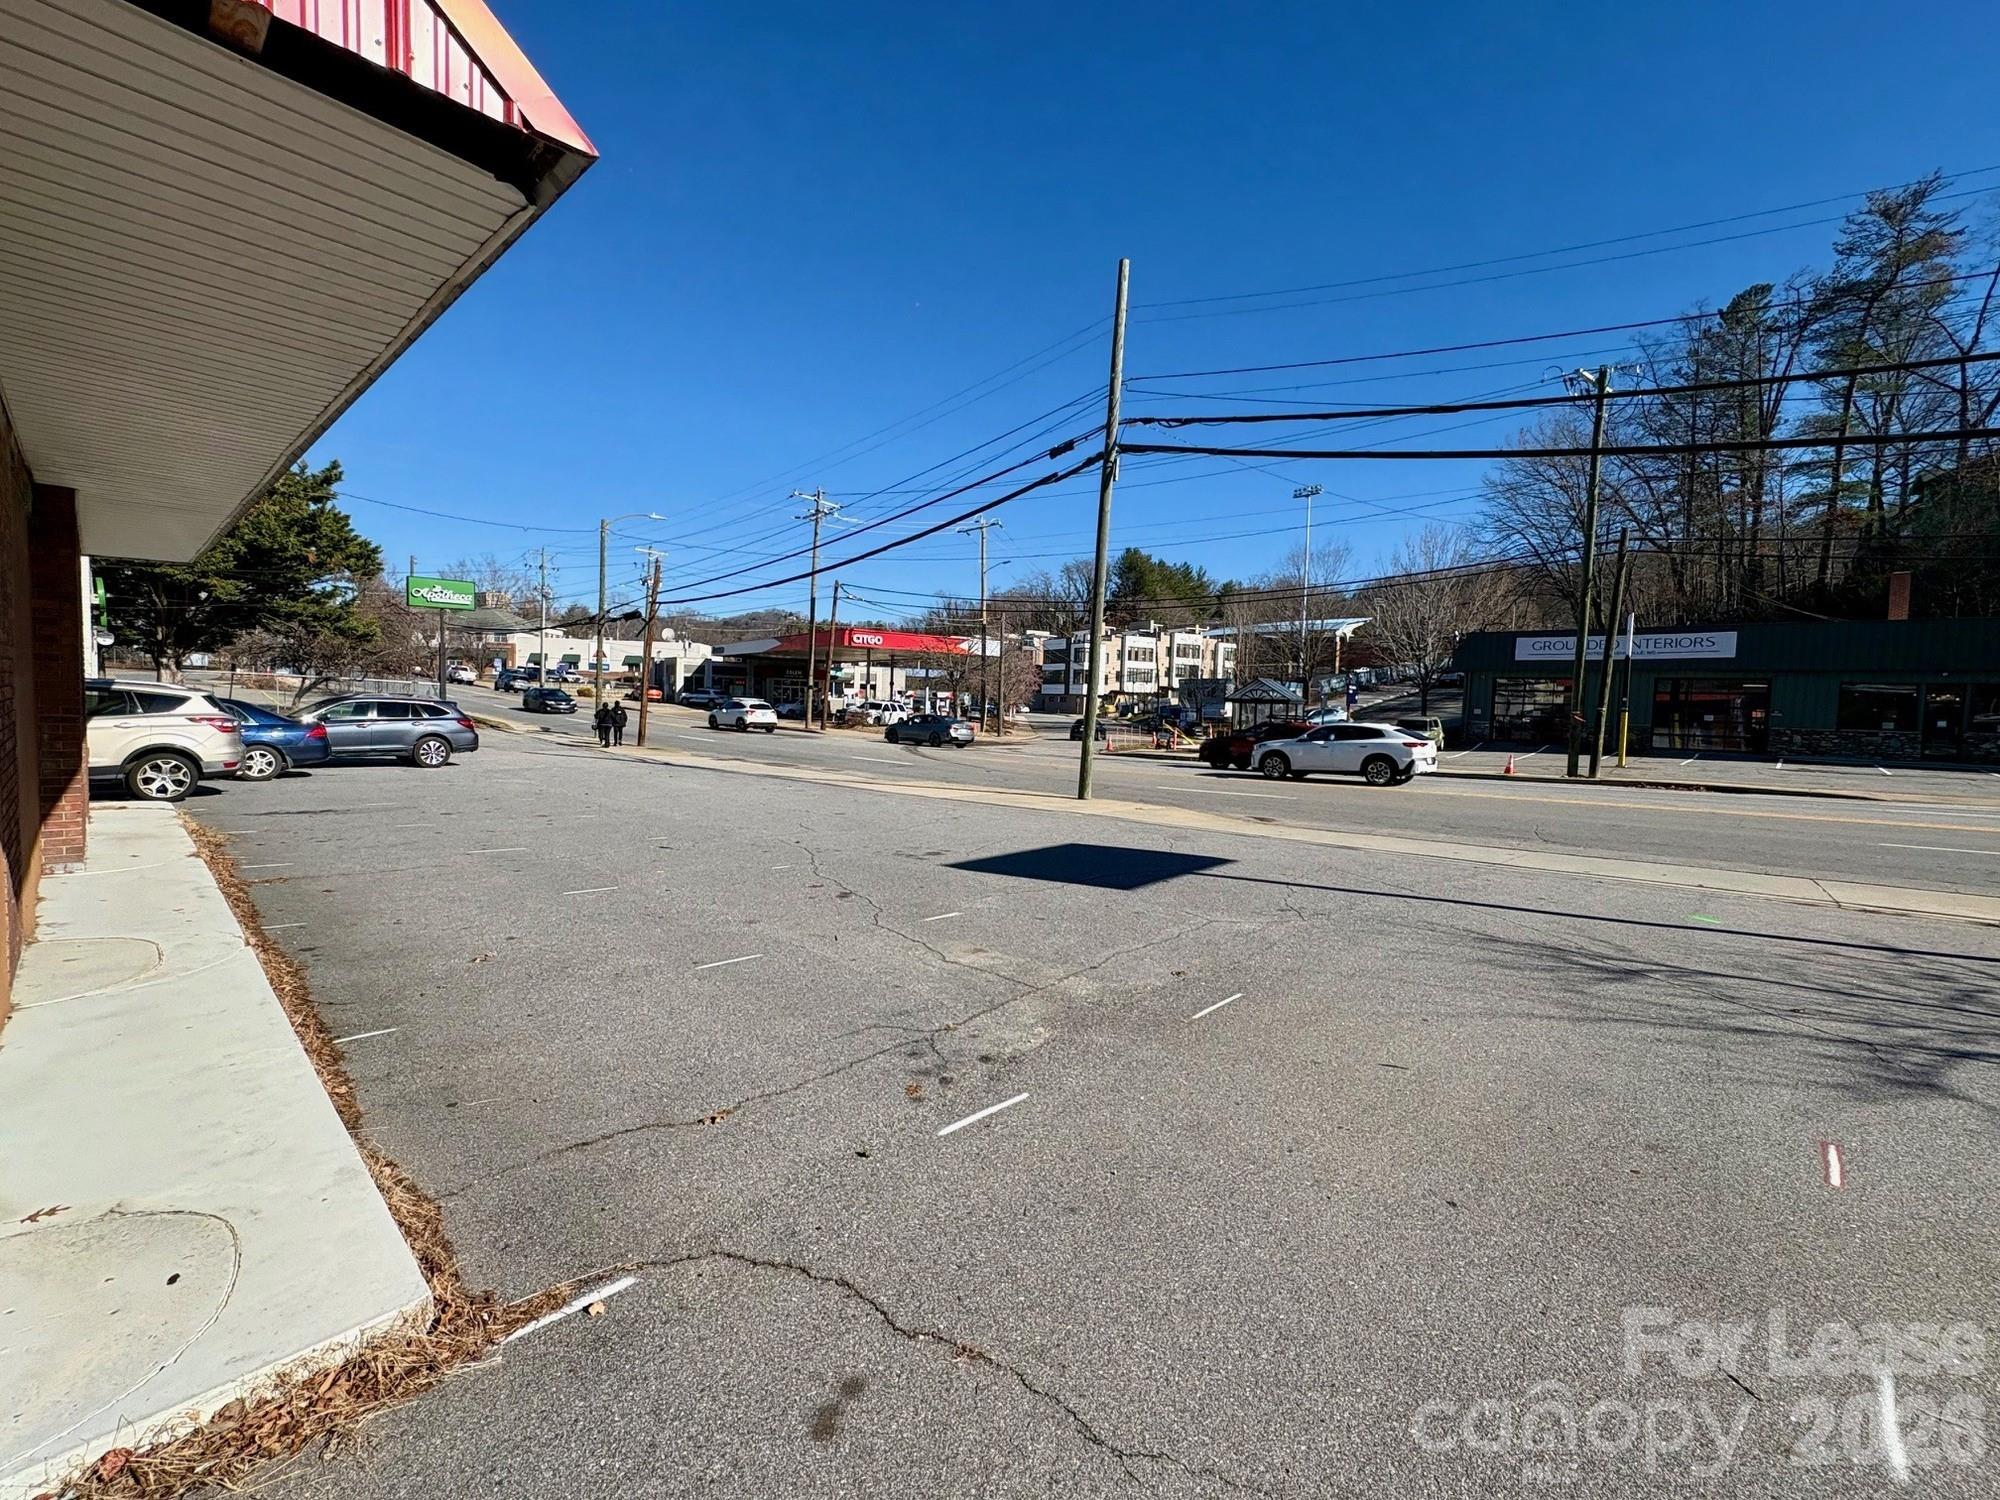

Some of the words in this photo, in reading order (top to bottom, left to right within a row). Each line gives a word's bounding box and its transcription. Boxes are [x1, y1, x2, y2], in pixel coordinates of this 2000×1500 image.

[411, 587, 473, 604] Apotheca
[852, 633, 883, 645] CITGO
[1531, 639, 1620, 651] GROUDED
[1629, 636, 1716, 649] NTERIORS
